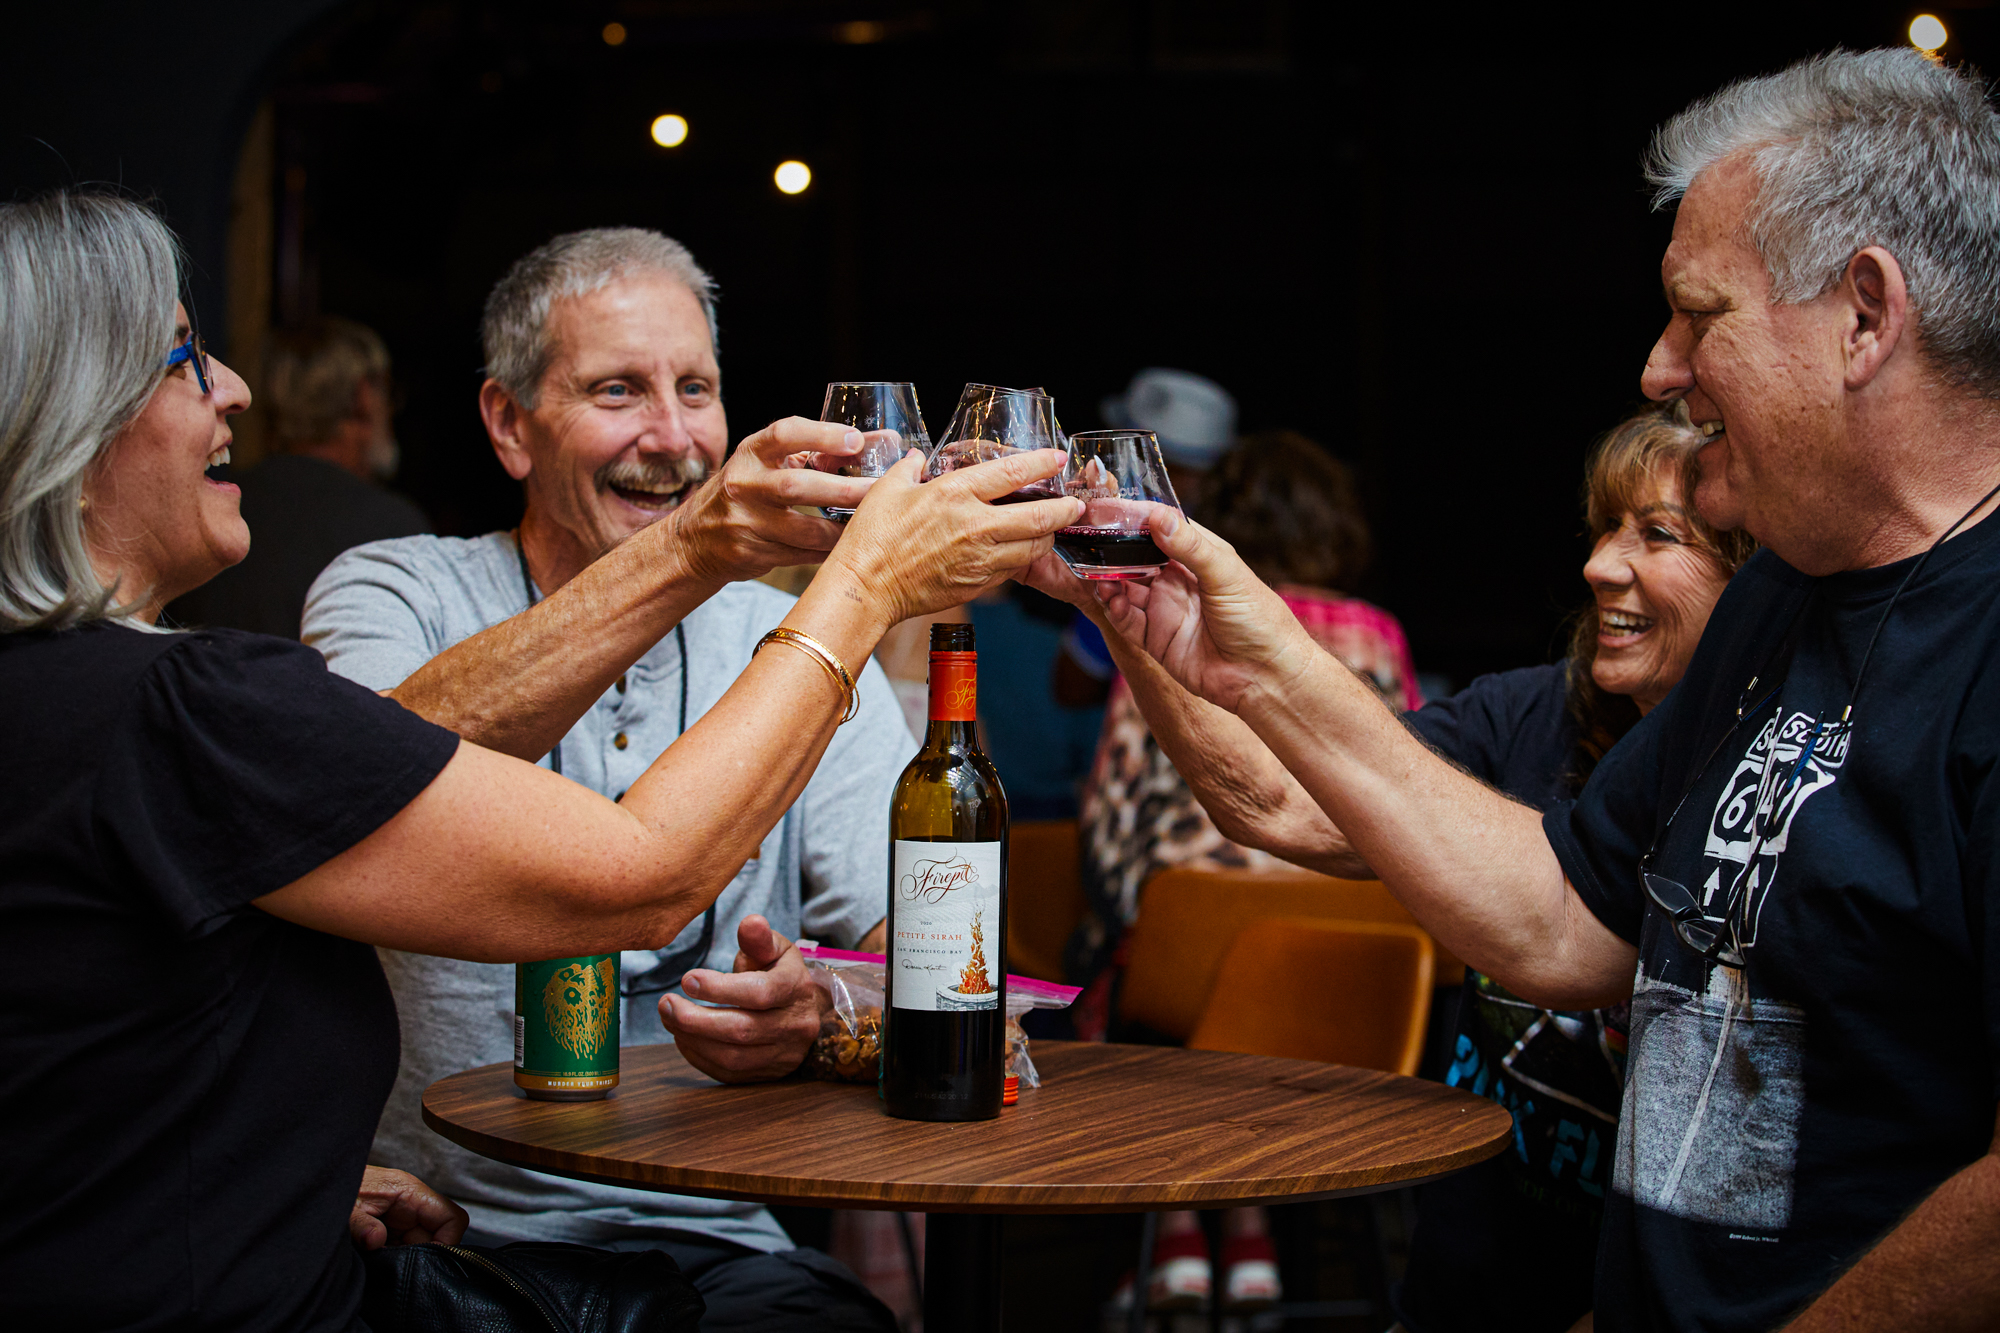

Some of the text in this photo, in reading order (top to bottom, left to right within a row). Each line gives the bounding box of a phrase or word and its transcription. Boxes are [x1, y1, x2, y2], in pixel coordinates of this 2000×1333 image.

[900, 846, 980, 905] Firepit
[897, 931, 962, 941] PETITE SIRAH
